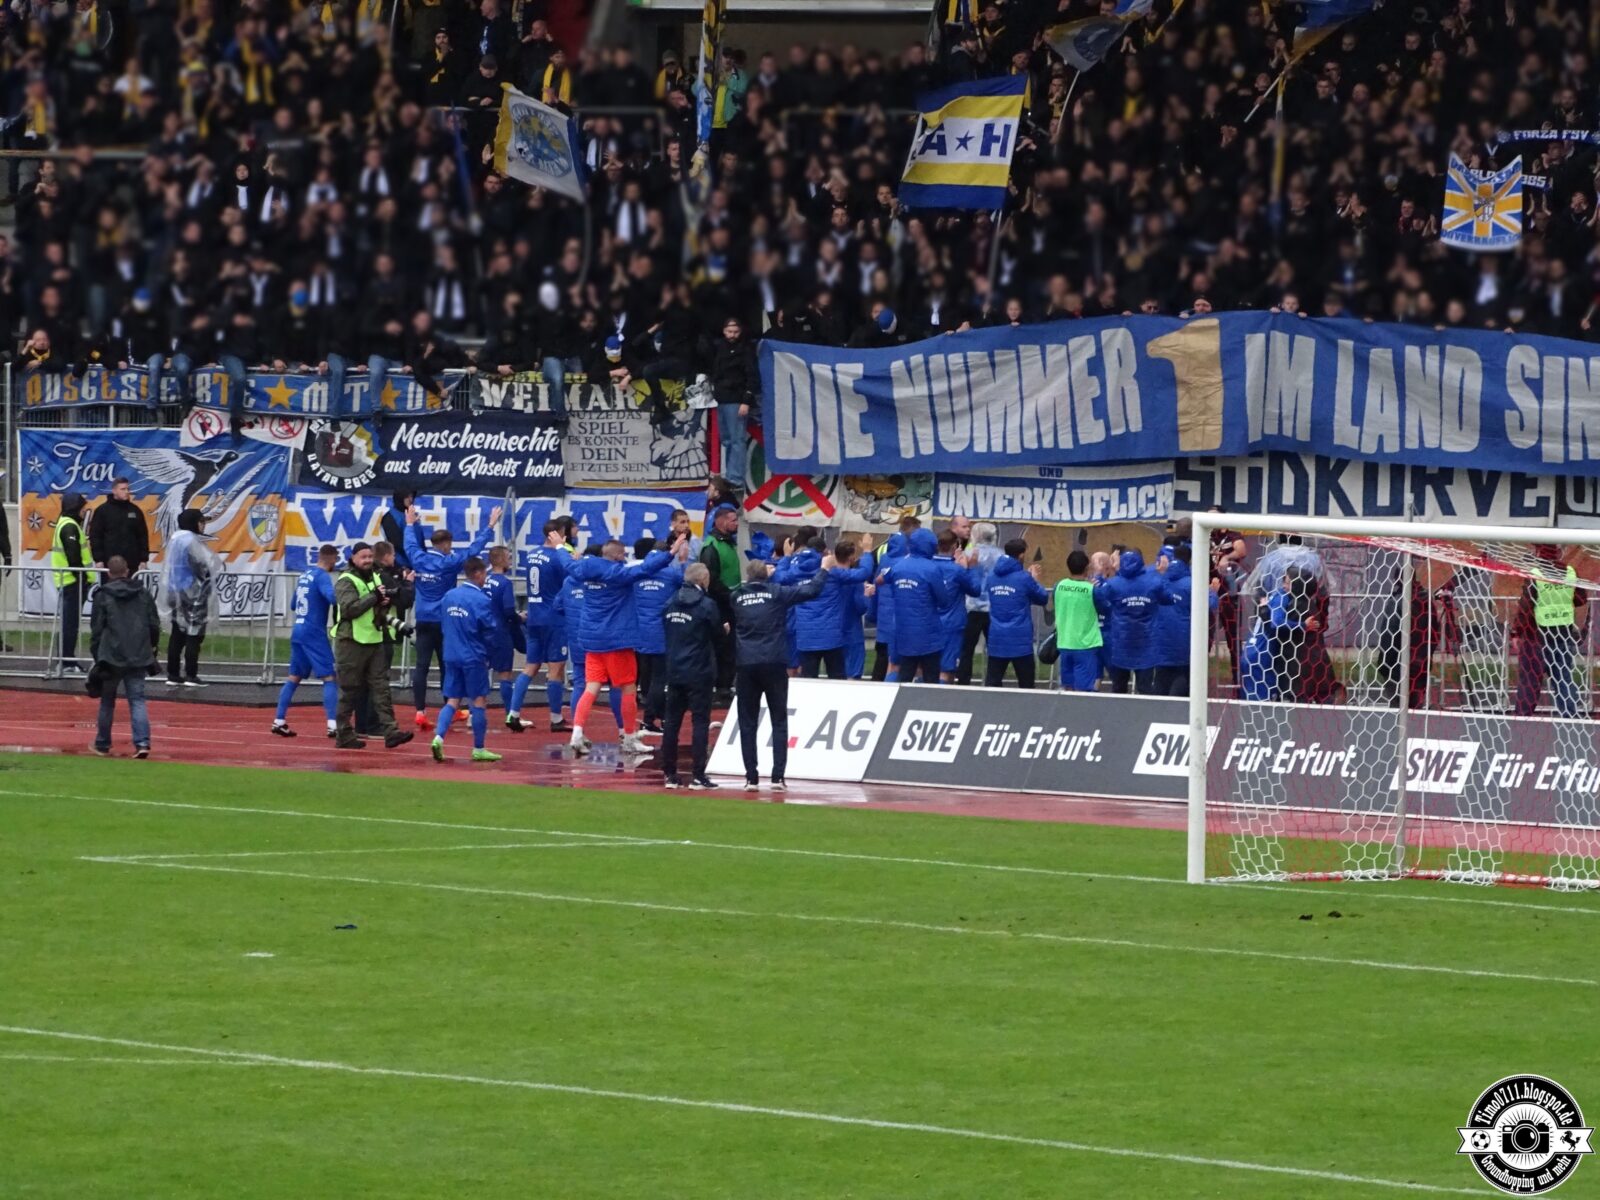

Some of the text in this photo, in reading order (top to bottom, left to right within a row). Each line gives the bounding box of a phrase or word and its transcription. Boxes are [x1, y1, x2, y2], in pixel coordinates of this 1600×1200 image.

[773, 351, 875, 464] DIE
[890, 327, 1143, 459] NUMMER
[1145, 318, 1224, 452] 1
[1245, 330, 1316, 443] IM
[1333, 339, 1483, 454] LAND
[390, 422, 560, 452] Menschenrechte
[567, 434, 640, 447] ES KÖNNTE
[578, 421, 630, 435] SPIEL
[50, 442, 117, 491] Fan
[384, 453, 564, 480] aus dem Abseits holen
[565, 461, 650, 473] LETZTES SEIN
[580, 447, 628, 461] DEIN
[344, 468, 377, 490] 2022
[1038, 466, 1064, 479] UND
[938, 481, 1173, 521] UNVERKÄUFLICH
[529, 566, 540, 595] 9
[1060, 584, 1089, 594] macron
[742, 597, 765, 606] JENA
[804, 709, 878, 752] AG
[900, 718, 1103, 763] SWE Für Erfurt.
[1145, 732, 1358, 778] SW Für Erfurt.
[1406, 747, 1469, 784] SWE
[1483, 753, 1536, 788] Für
